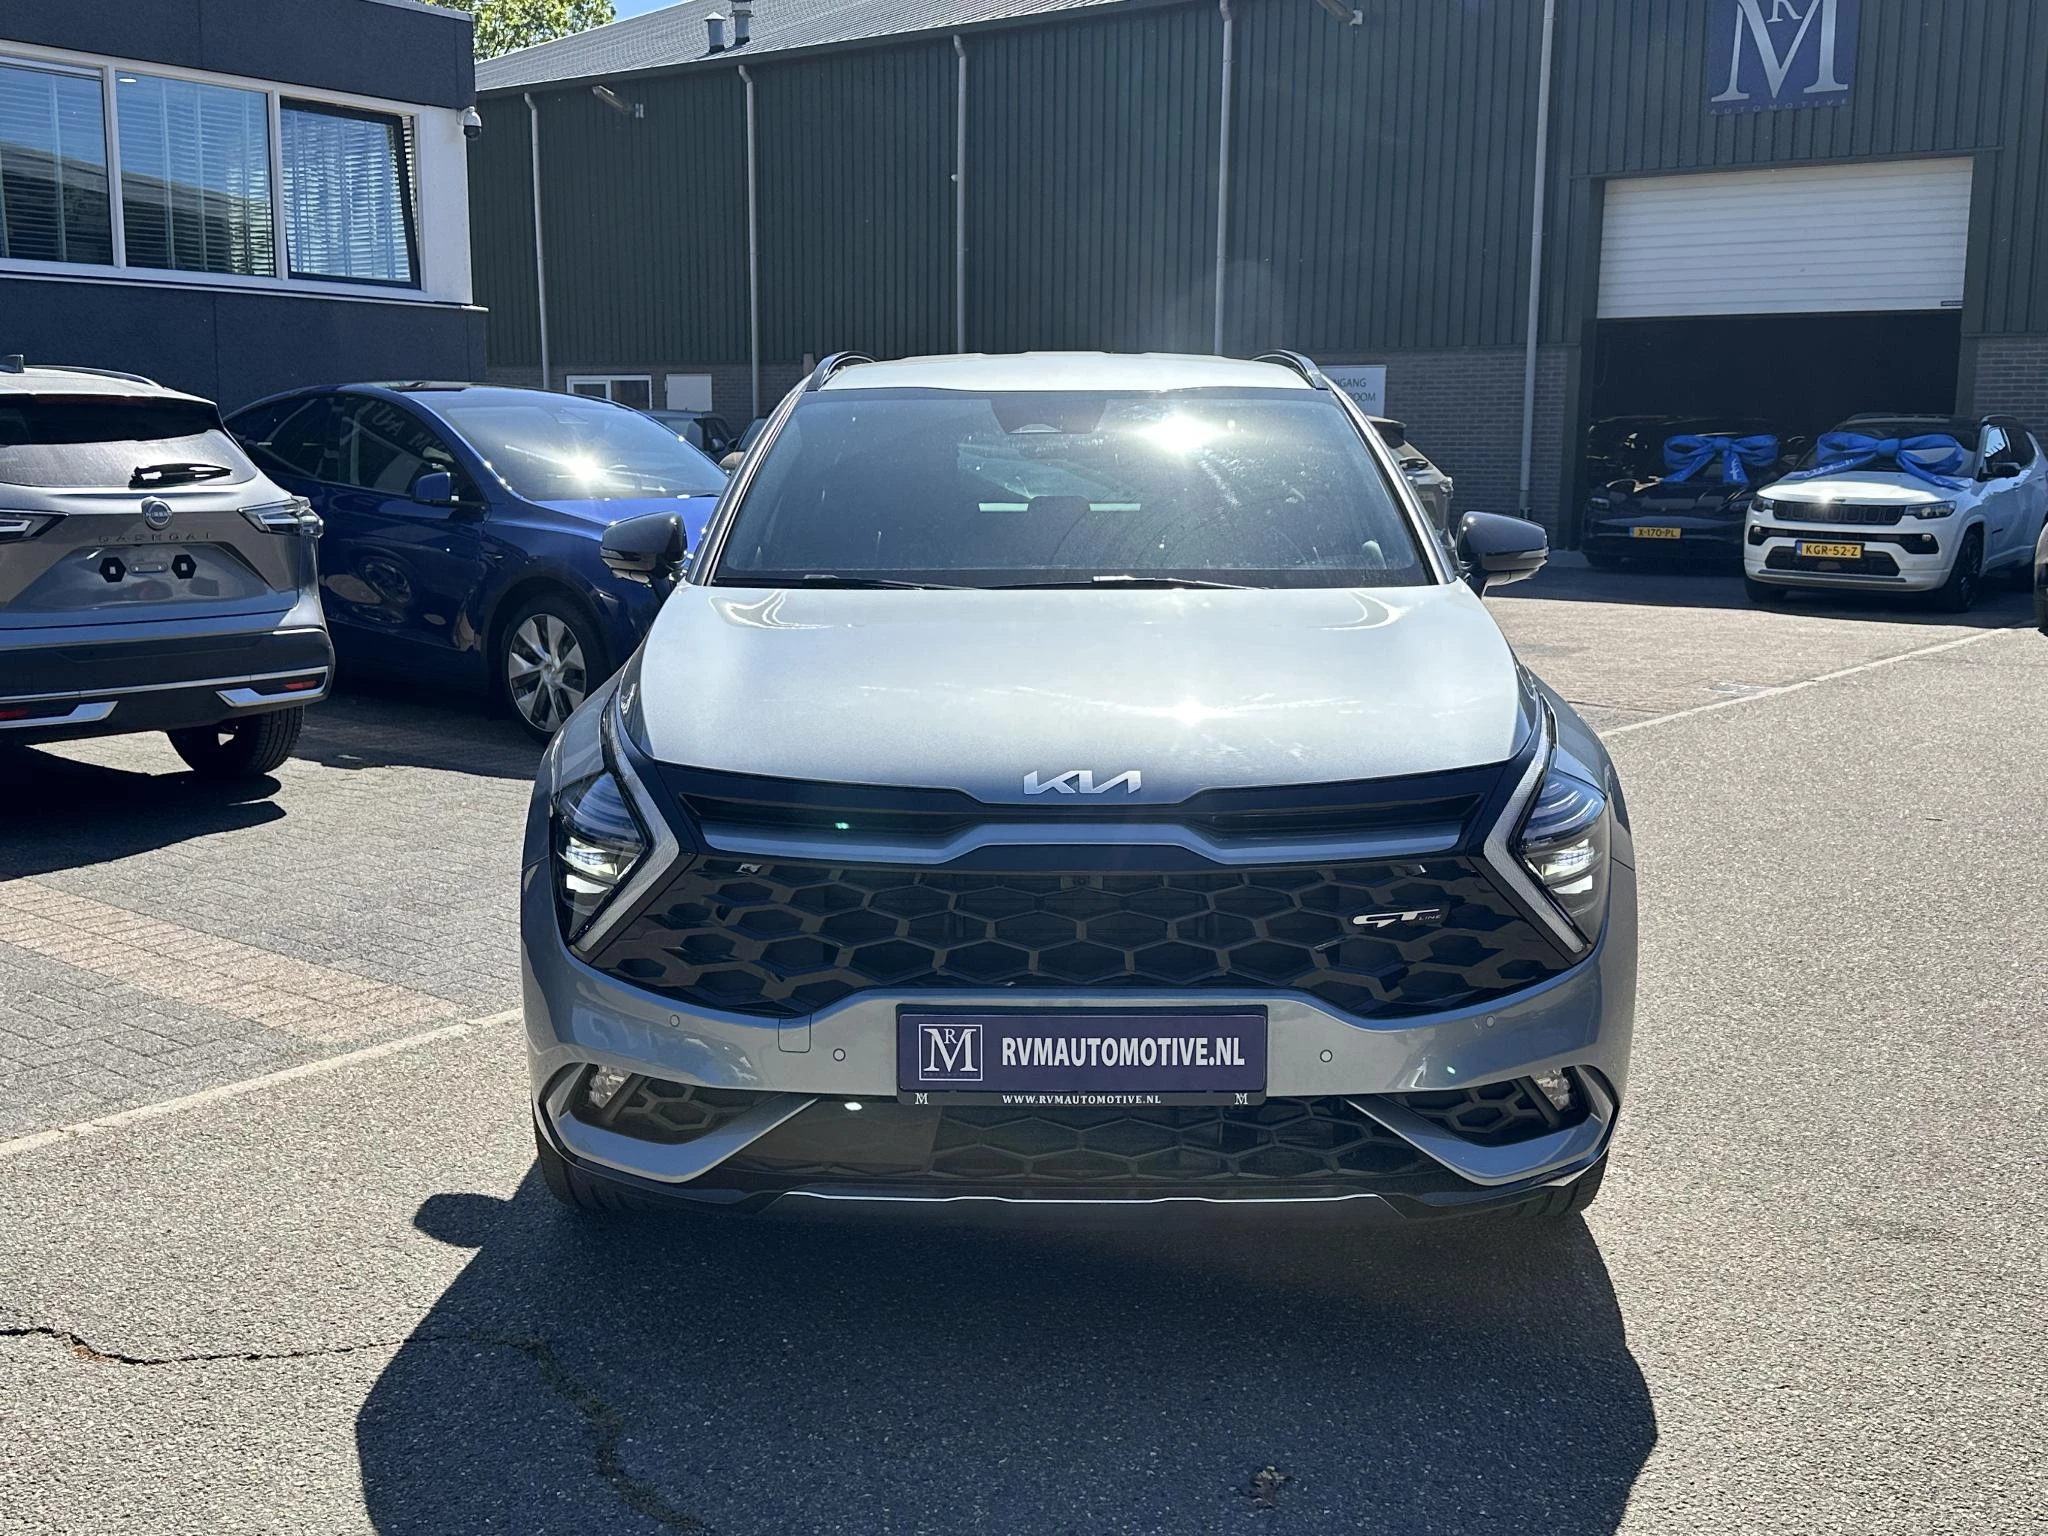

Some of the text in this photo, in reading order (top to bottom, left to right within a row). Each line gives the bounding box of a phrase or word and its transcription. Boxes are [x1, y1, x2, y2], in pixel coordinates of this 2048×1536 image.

[1710, 99, 1849, 115] AUTOMOTIVE
[1334, 377, 1367, 388] NGANG
[1638, 528, 1677, 538] X-170-PL
[1805, 544, 1859, 557] KGR-52-Z
[1002, 1037, 1245, 1067] RVMAUTOMOTIVE.NL
[1002, 1094, 1162, 1105] WWW.RVMAUTOMOTIVE.NL
